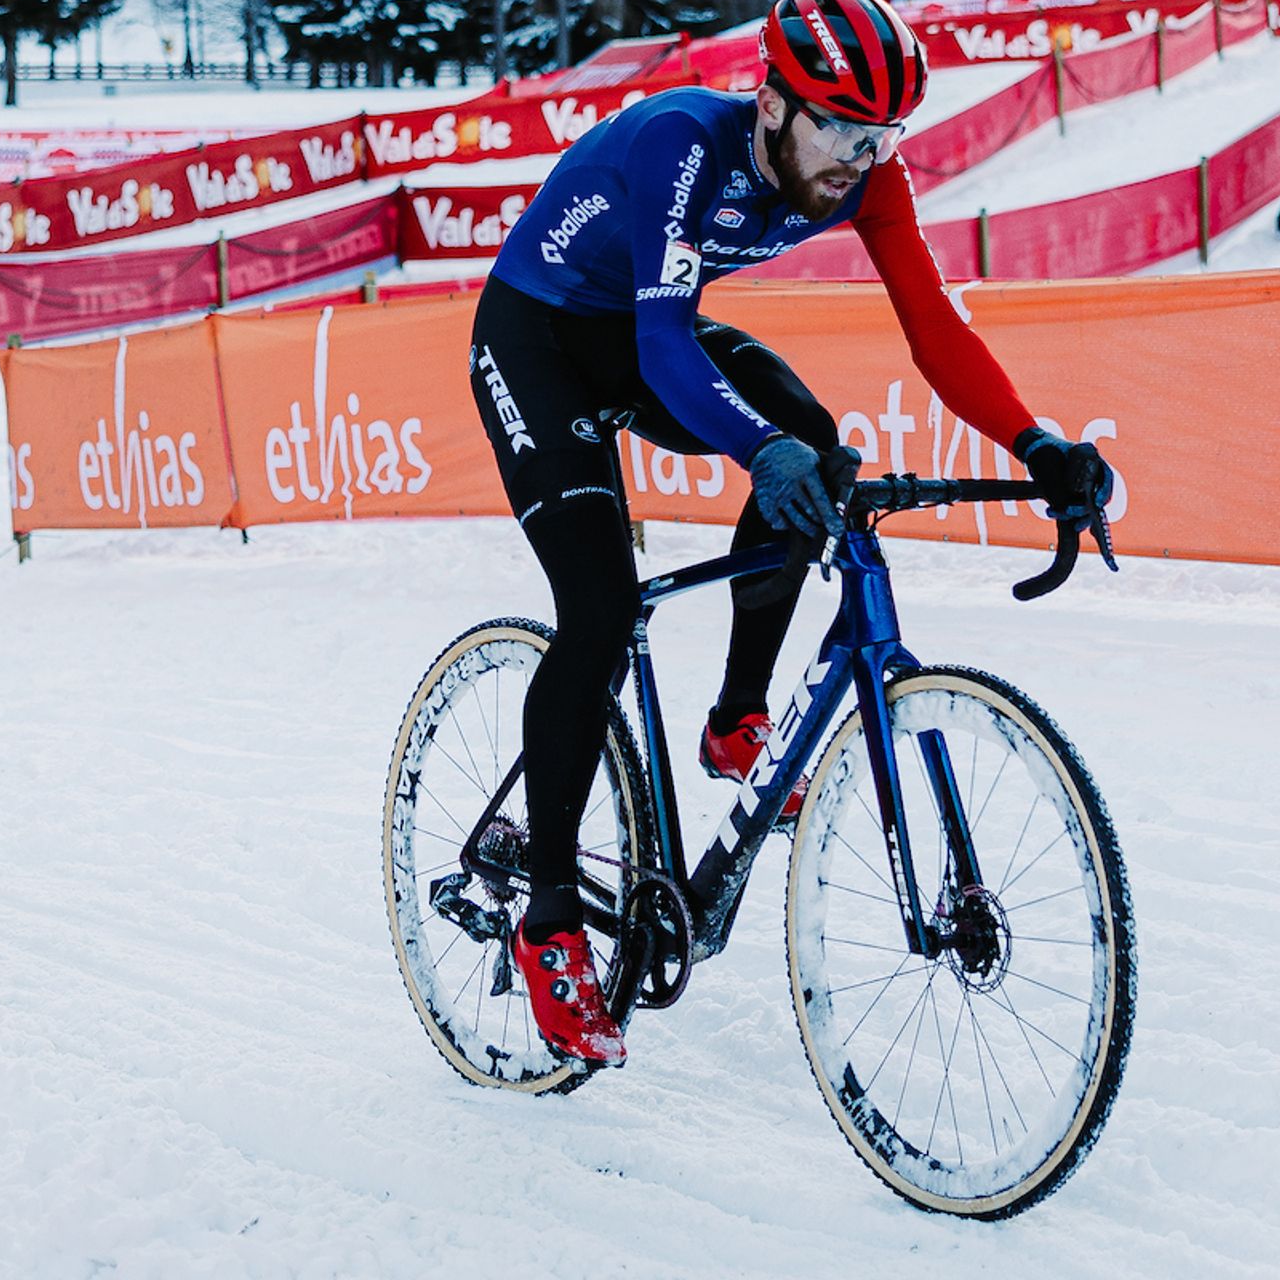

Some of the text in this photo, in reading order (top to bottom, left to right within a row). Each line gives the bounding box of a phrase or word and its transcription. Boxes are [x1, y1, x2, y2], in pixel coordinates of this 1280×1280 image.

[807, 9, 848, 71] TREK
[668, 144, 705, 220] baloise
[548, 194, 610, 250] baloise
[636, 285, 694, 301] SRAM
[673, 258, 693, 287] 2
[77, 336, 205, 529] ethias
[265, 305, 433, 521] ethias
[478, 344, 537, 455] TREK
[712, 379, 772, 429] TREK
[707, 650, 833, 855] TREK
[887, 824, 914, 921] TREK
